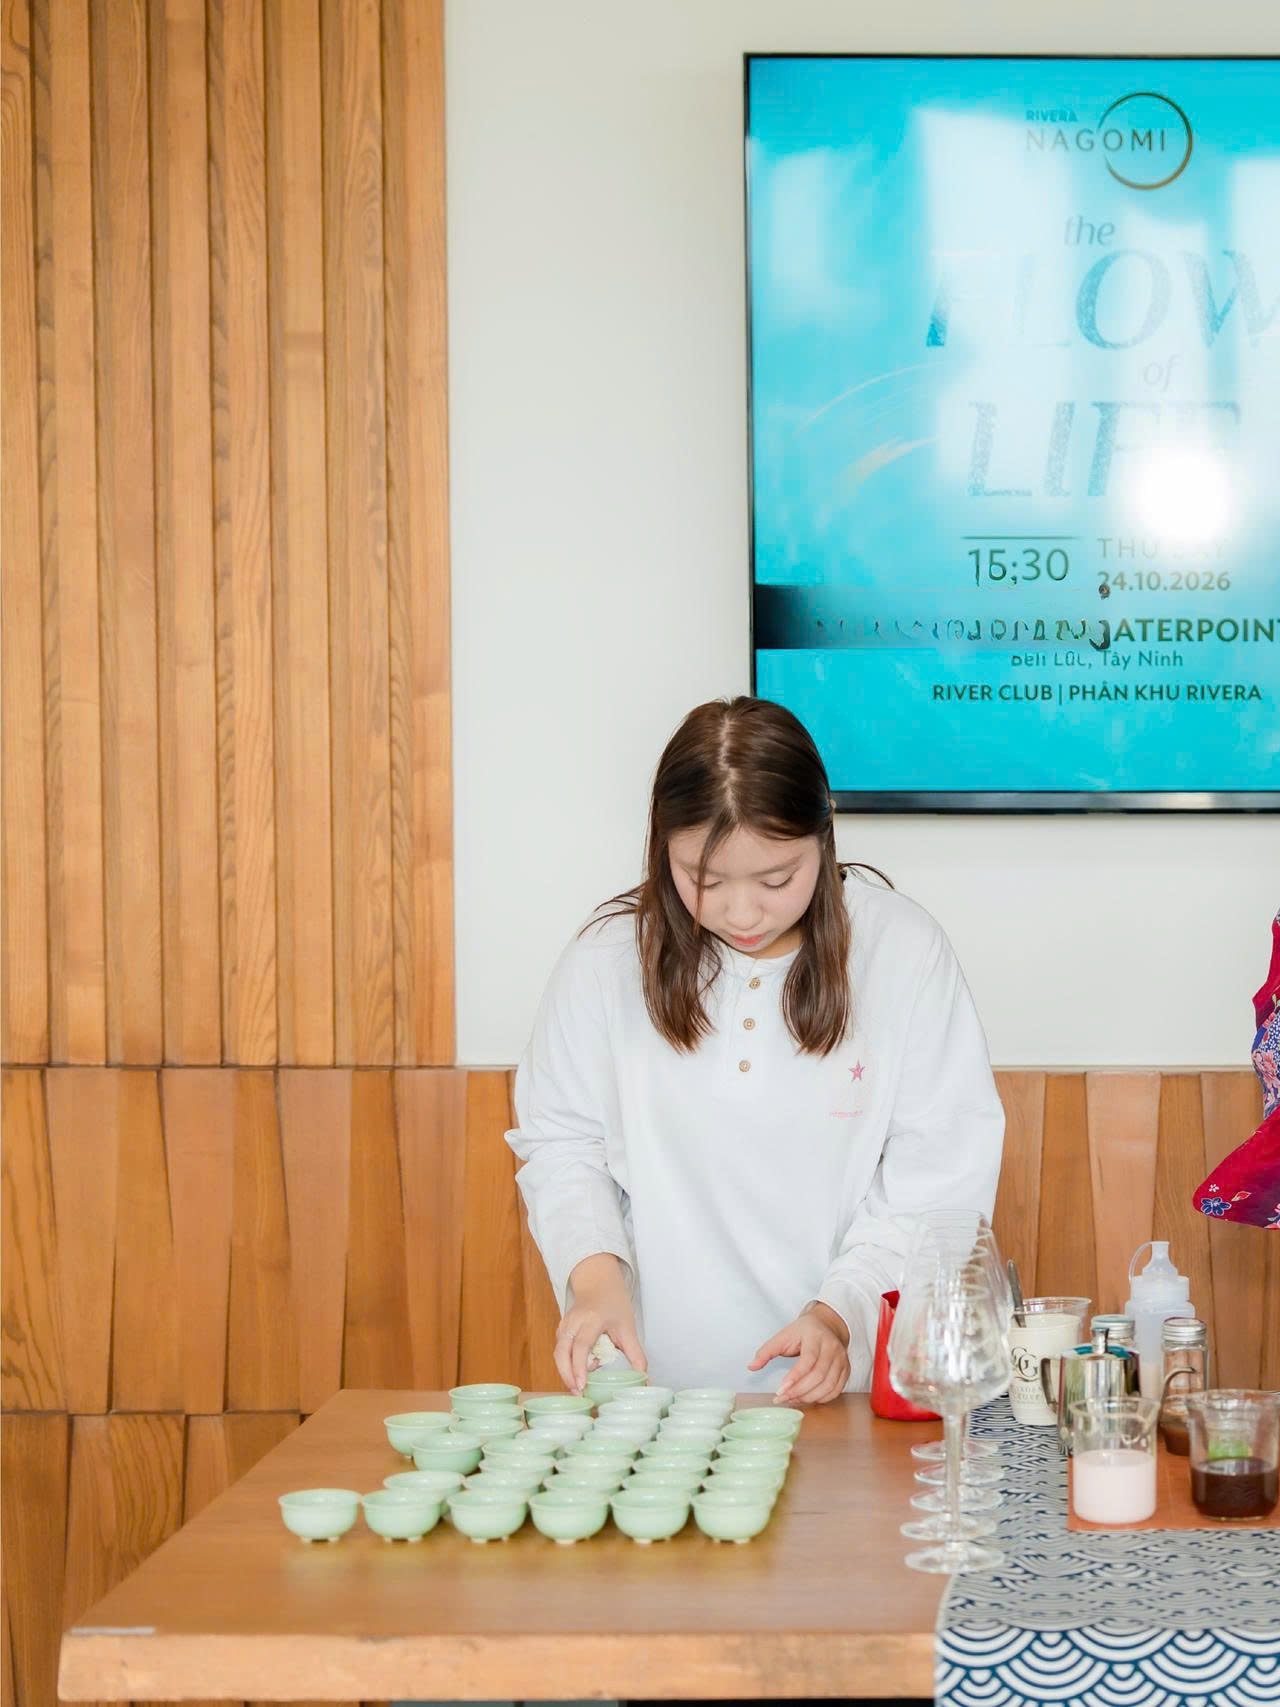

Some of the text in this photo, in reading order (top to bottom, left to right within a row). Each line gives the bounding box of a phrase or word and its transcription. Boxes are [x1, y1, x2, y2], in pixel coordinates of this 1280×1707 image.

[1025, 110, 1079, 122] RIVERA
[1026, 128, 1166, 152] NAGOMI
[1063, 216, 1115, 248] the
[1142, 354, 1184, 392] of
[1096, 570, 1231, 592] 24.10.2026
[1102, 649, 1131, 671] Tây
[1138, 649, 1183, 667] Ninh
[932, 680, 1263, 701] RIVER CLUB PHÂN KHU RIVERA
